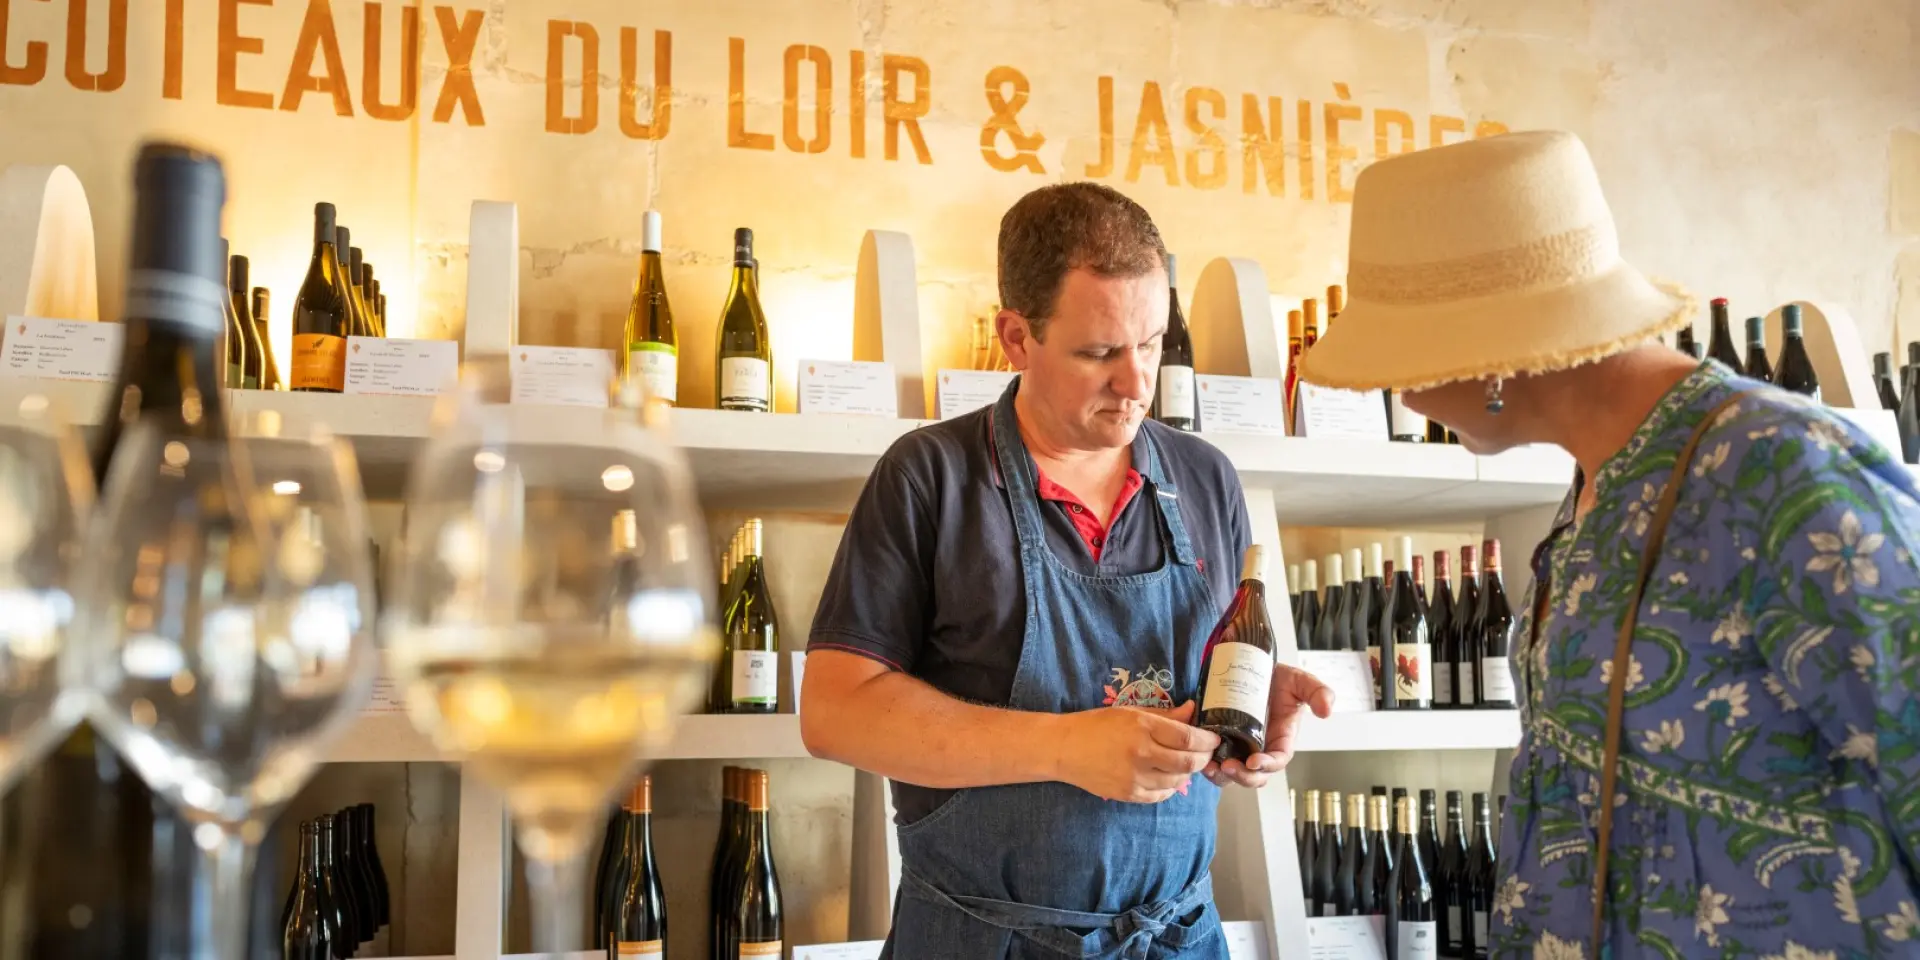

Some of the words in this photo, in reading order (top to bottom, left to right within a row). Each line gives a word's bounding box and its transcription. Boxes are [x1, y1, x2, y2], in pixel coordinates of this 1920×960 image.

[545, 19, 672, 141] DU
[728, 36, 934, 165] LOIR
[980, 65, 1047, 175] &
[1084, 75, 1510, 204] JASNIÈ
